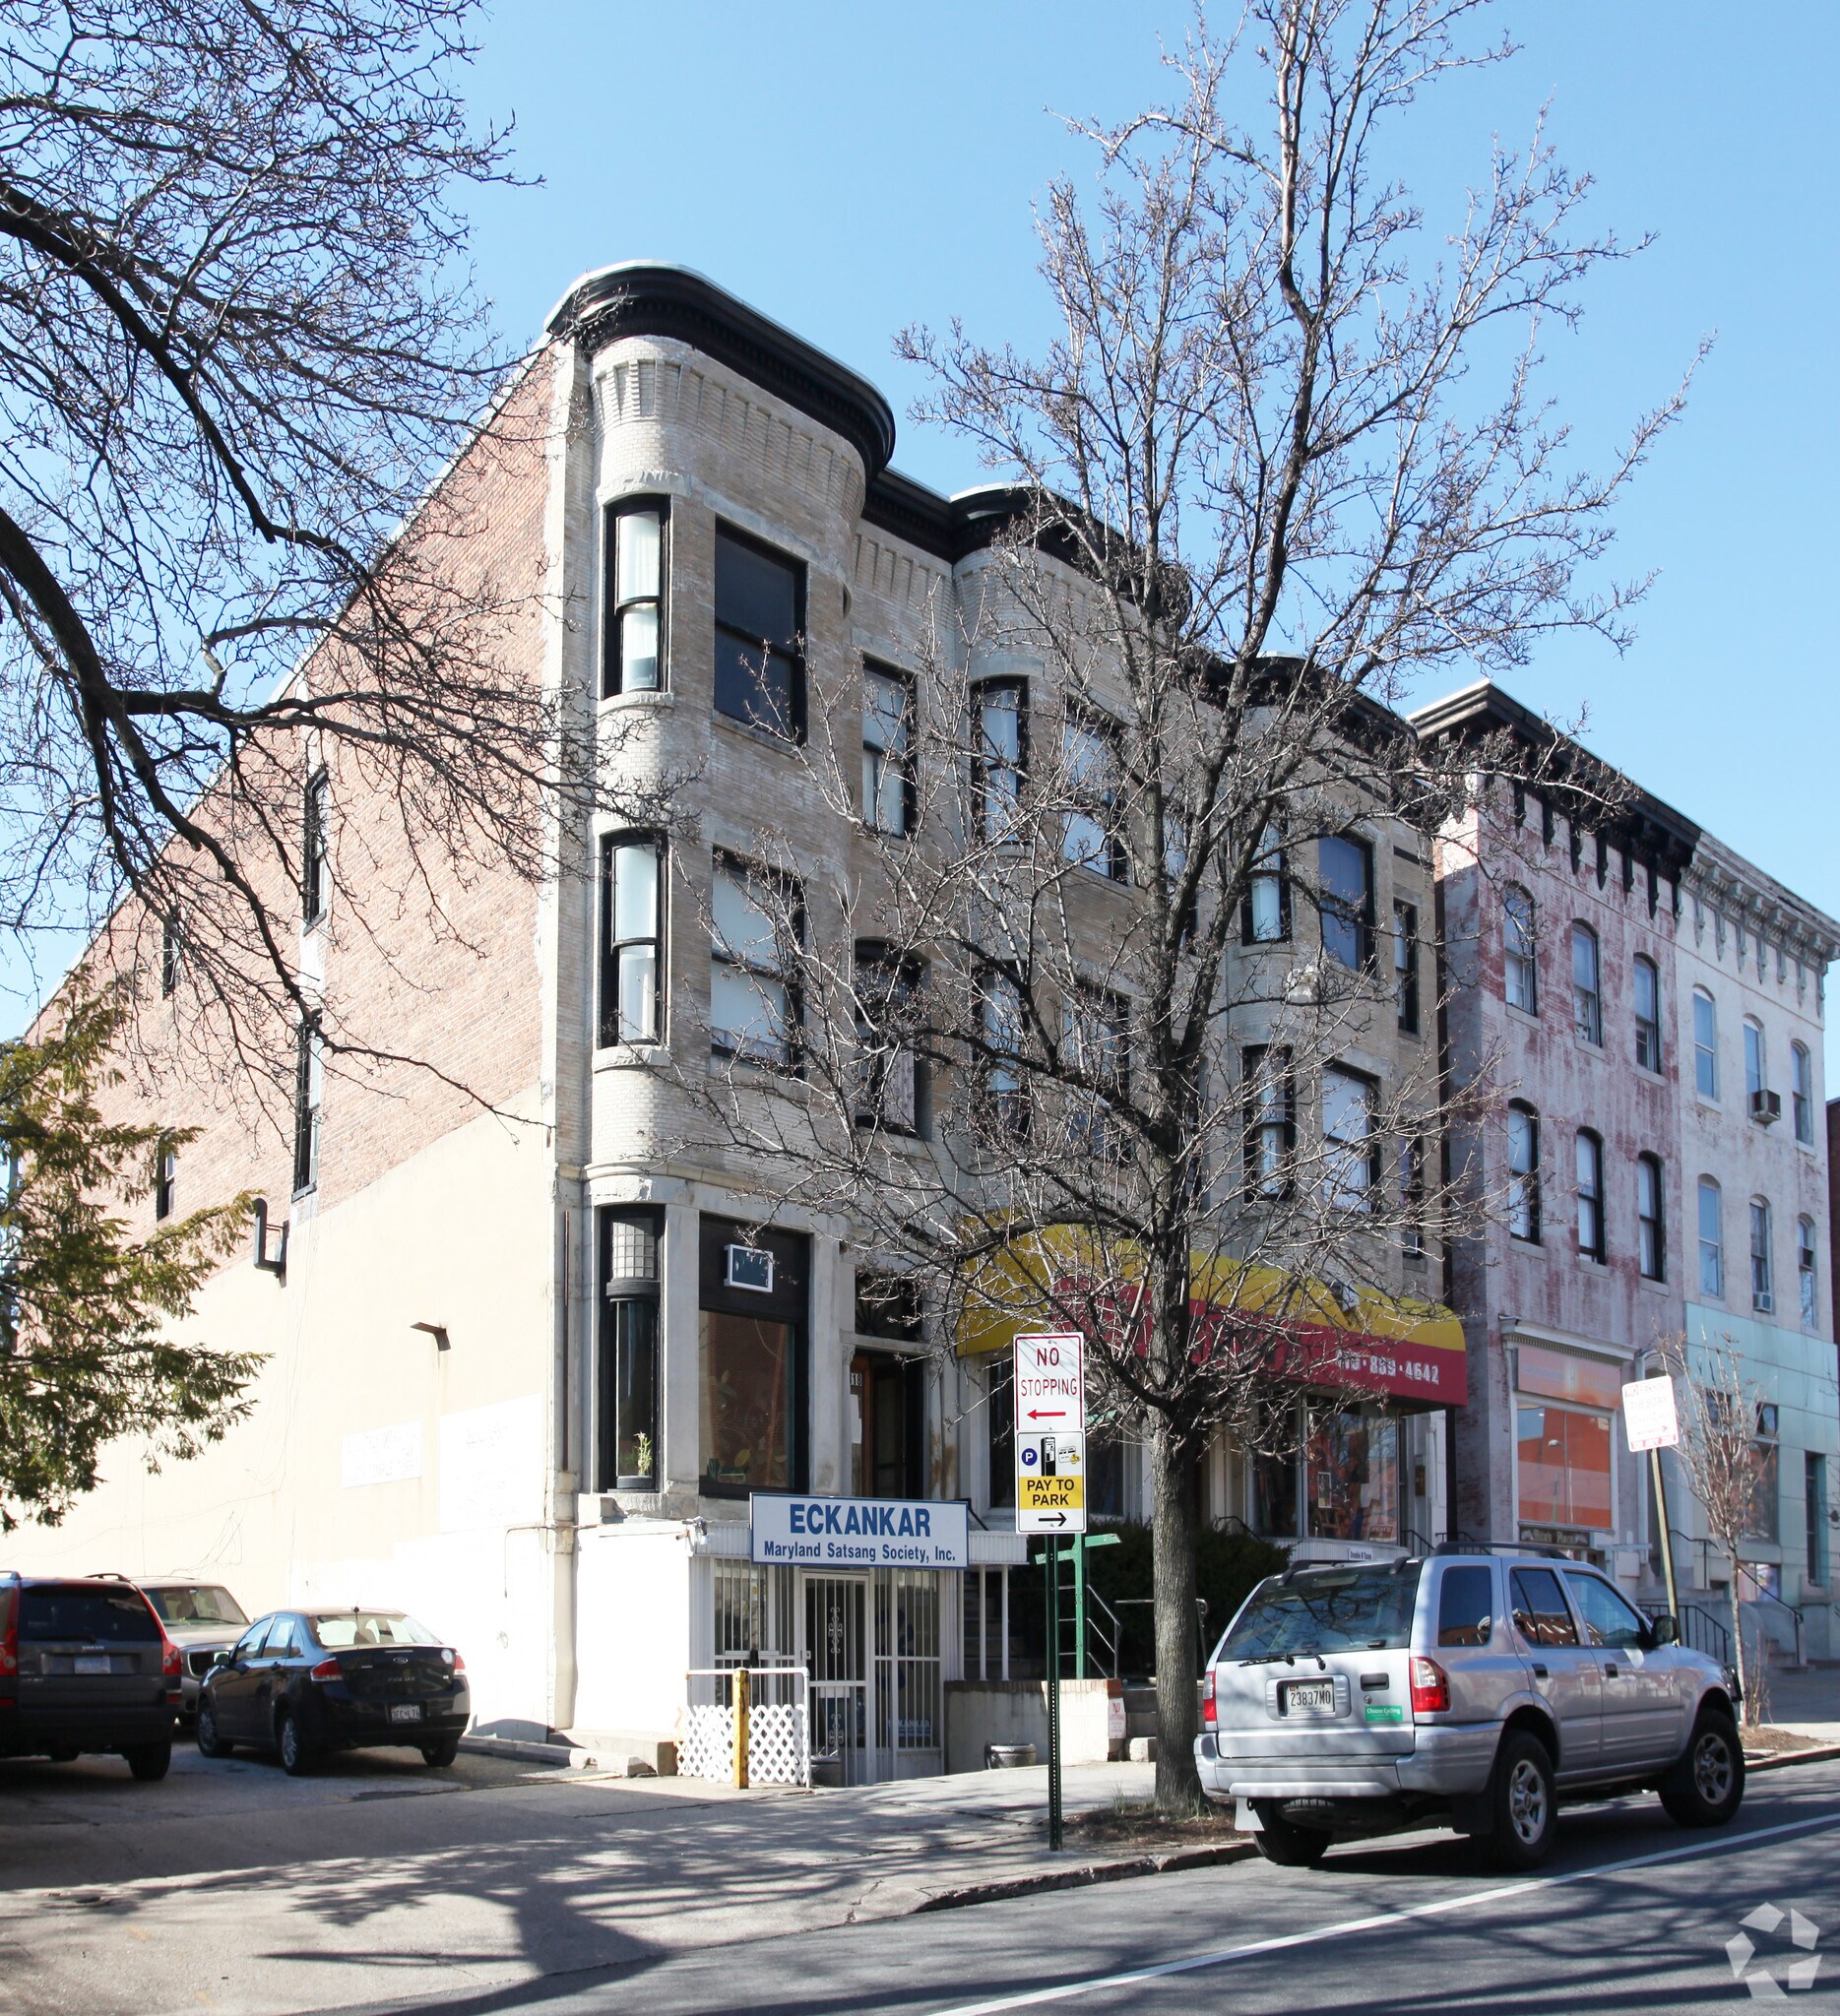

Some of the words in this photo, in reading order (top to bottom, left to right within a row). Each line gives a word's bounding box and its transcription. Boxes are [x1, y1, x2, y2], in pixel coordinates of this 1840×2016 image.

[1037, 1347, 1060, 1366] NO
[1020, 1378, 1078, 1397] STOPPING
[1025, 1452, 1034, 1463] P
[1027, 1480, 1052, 1491] PAY
[1055, 1479, 1075, 1491] TO
[1032, 1493, 1069, 1506] PARK
[790, 1503, 930, 1538] ECKANKAR
[764, 1541, 821, 1560] Maryland
[827, 1542, 876, 1562] Satsang
[882, 1544, 929, 1564] Society,
[934, 1545, 956, 1561] Inc.
[1383, 1707, 1401, 1716] Cycling
